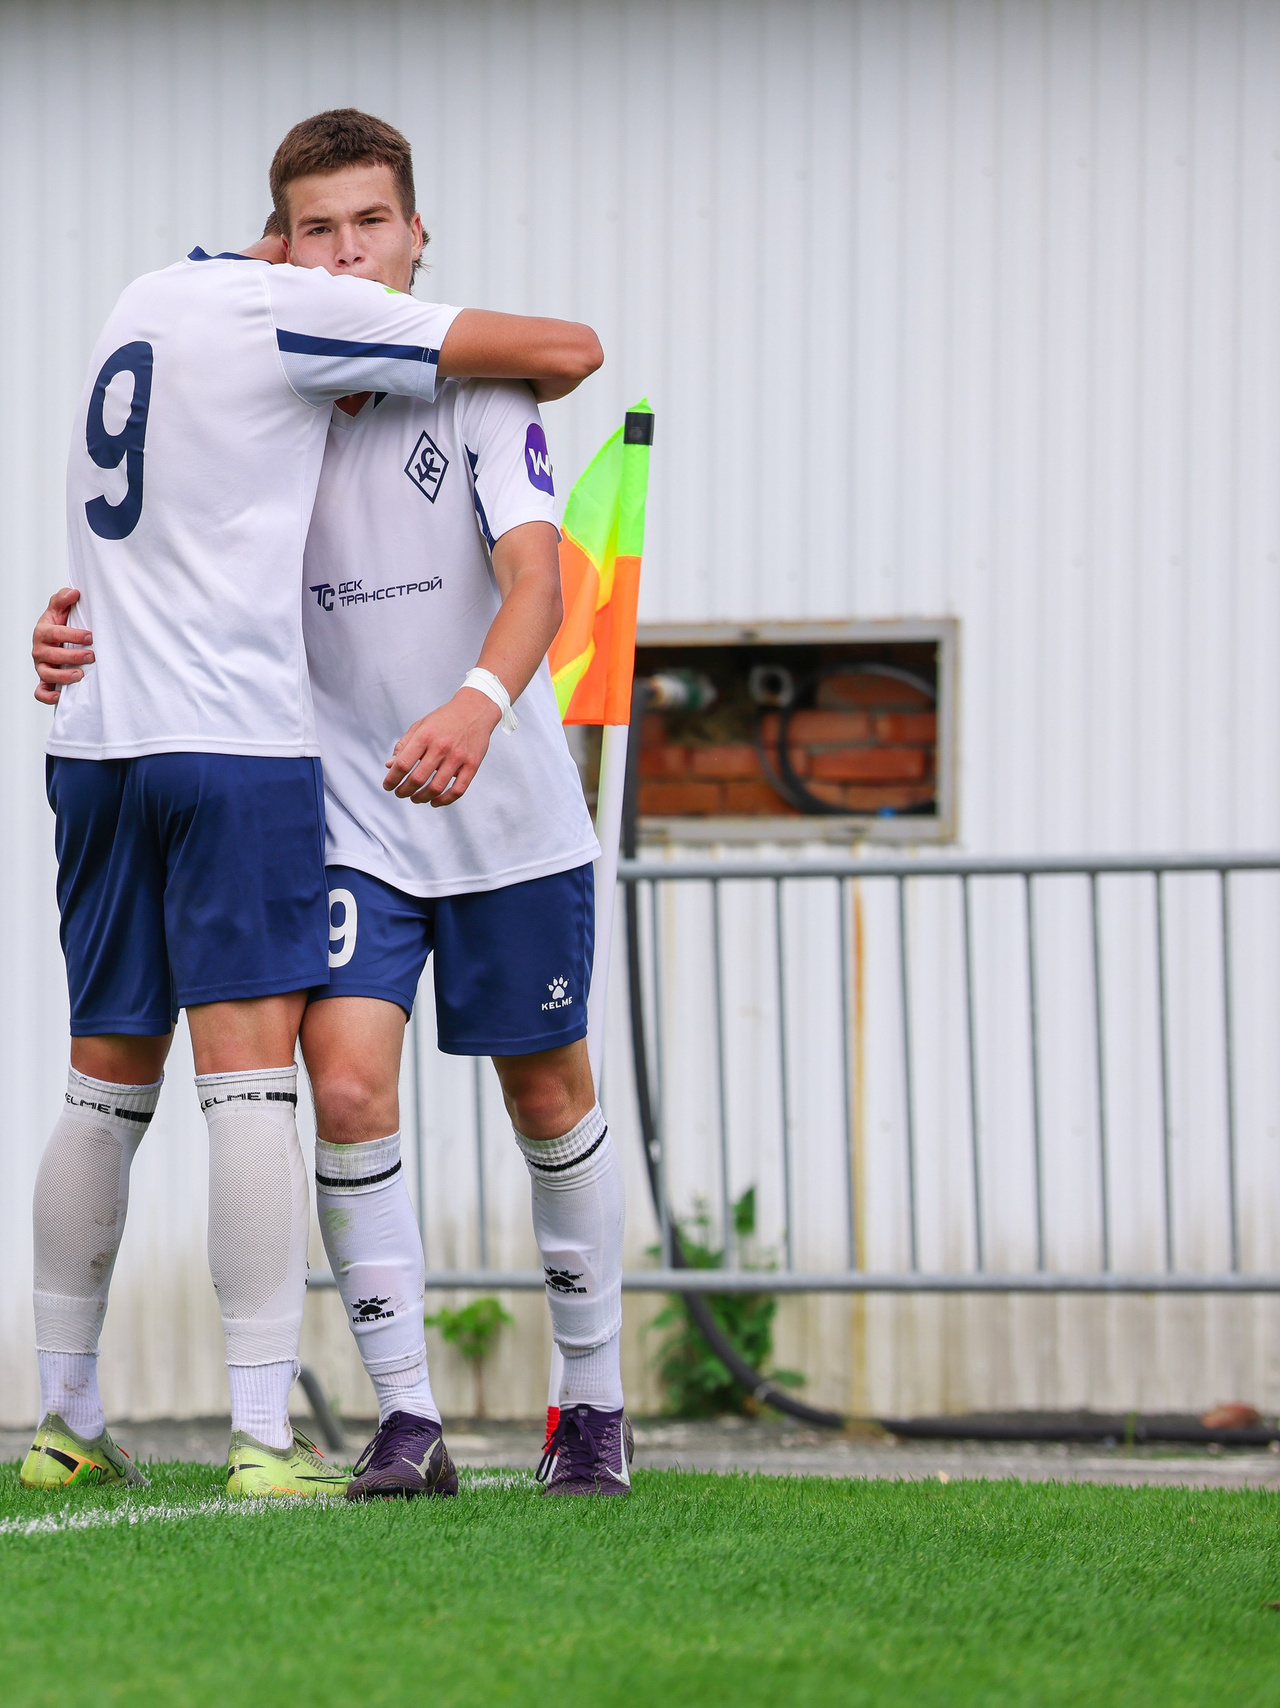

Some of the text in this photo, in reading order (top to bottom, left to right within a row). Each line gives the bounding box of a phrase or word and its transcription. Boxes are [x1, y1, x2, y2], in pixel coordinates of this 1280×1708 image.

[84, 341, 154, 540] 9
[338, 576, 443, 607] ТРАНССТРОЙ
[328, 888, 358, 969] 9
[541, 996, 573, 1011] KELME
[352, 1310, 395, 1323] KELME
